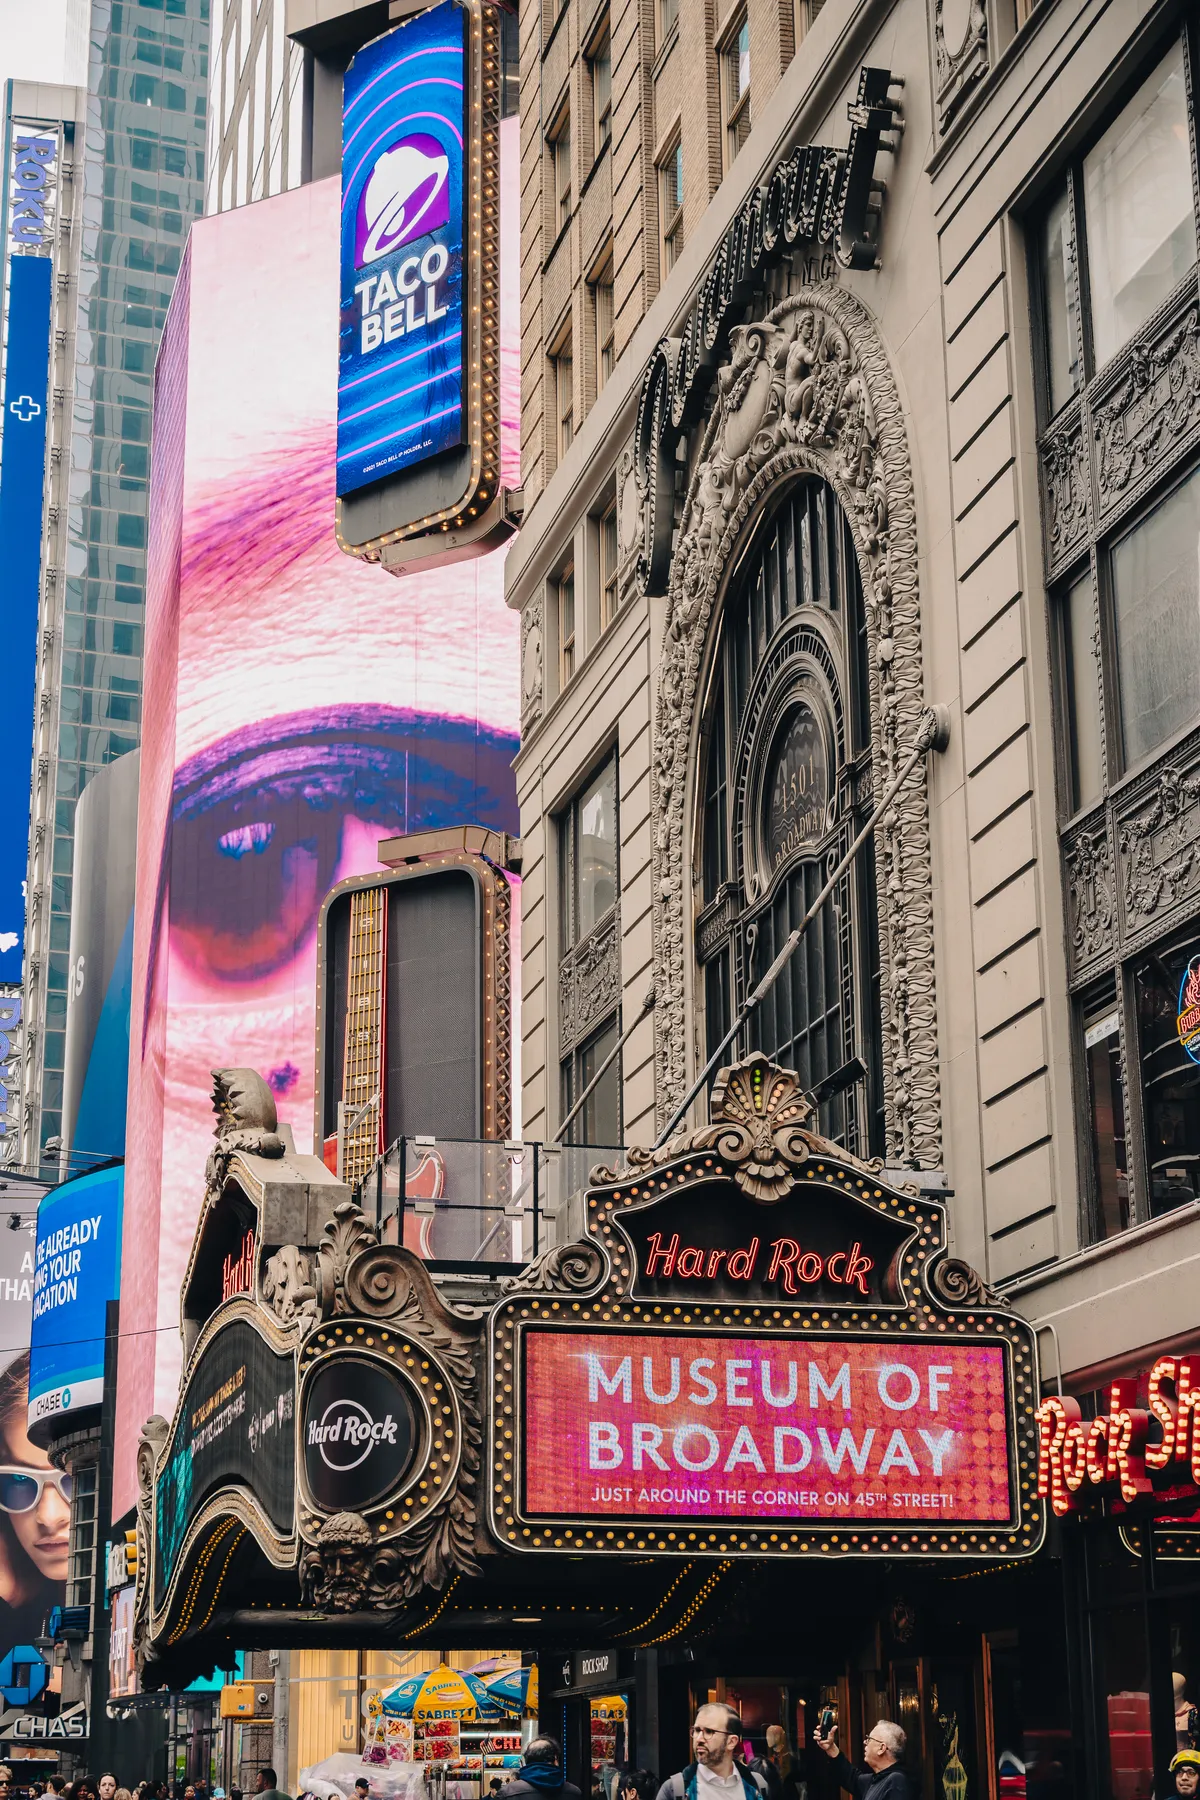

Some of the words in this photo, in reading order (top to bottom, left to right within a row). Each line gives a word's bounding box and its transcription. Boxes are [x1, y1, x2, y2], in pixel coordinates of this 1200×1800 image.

[354, 244, 449, 317] TACO
[361, 284, 450, 355] BELL
[376, 458, 387, 468] TACO
[387, 453, 399, 463] BELL
[782, 754, 815, 814] 1501
[45, 1215, 102, 1260] ALREADY
[49, 1248, 82, 1283] YOUR
[223, 1236, 245, 1303] Hard
[646, 1232, 759, 1279] Hard
[768, 1237, 876, 1295] Rock
[36, 1393, 61, 1416] CHASE
[588, 1353, 851, 1410] MUSEUM
[877, 1363, 954, 1412] OF
[308, 1416, 344, 1446] Hard
[343, 1414, 399, 1446] Rock
[588, 1420, 955, 1477] BROADWAY
[1034, 1378, 1148, 1518] Rock
[590, 1487, 633, 1503] JUST
[637, 1488, 711, 1505] AROUND
[715, 1490, 747, 1506] THE
[751, 1490, 819, 1507] CORNER
[823, 1492, 850, 1507] ON
[853, 1493, 888, 1508] 45TH
[892, 1493, 954, 1509] STREET!
[582, 1658, 595, 1676] ROCK
[595, 1655, 609, 1673] SHOP
[425, 1682, 462, 1696] SABRETT
[417, 1707, 475, 1721] SABRETT
